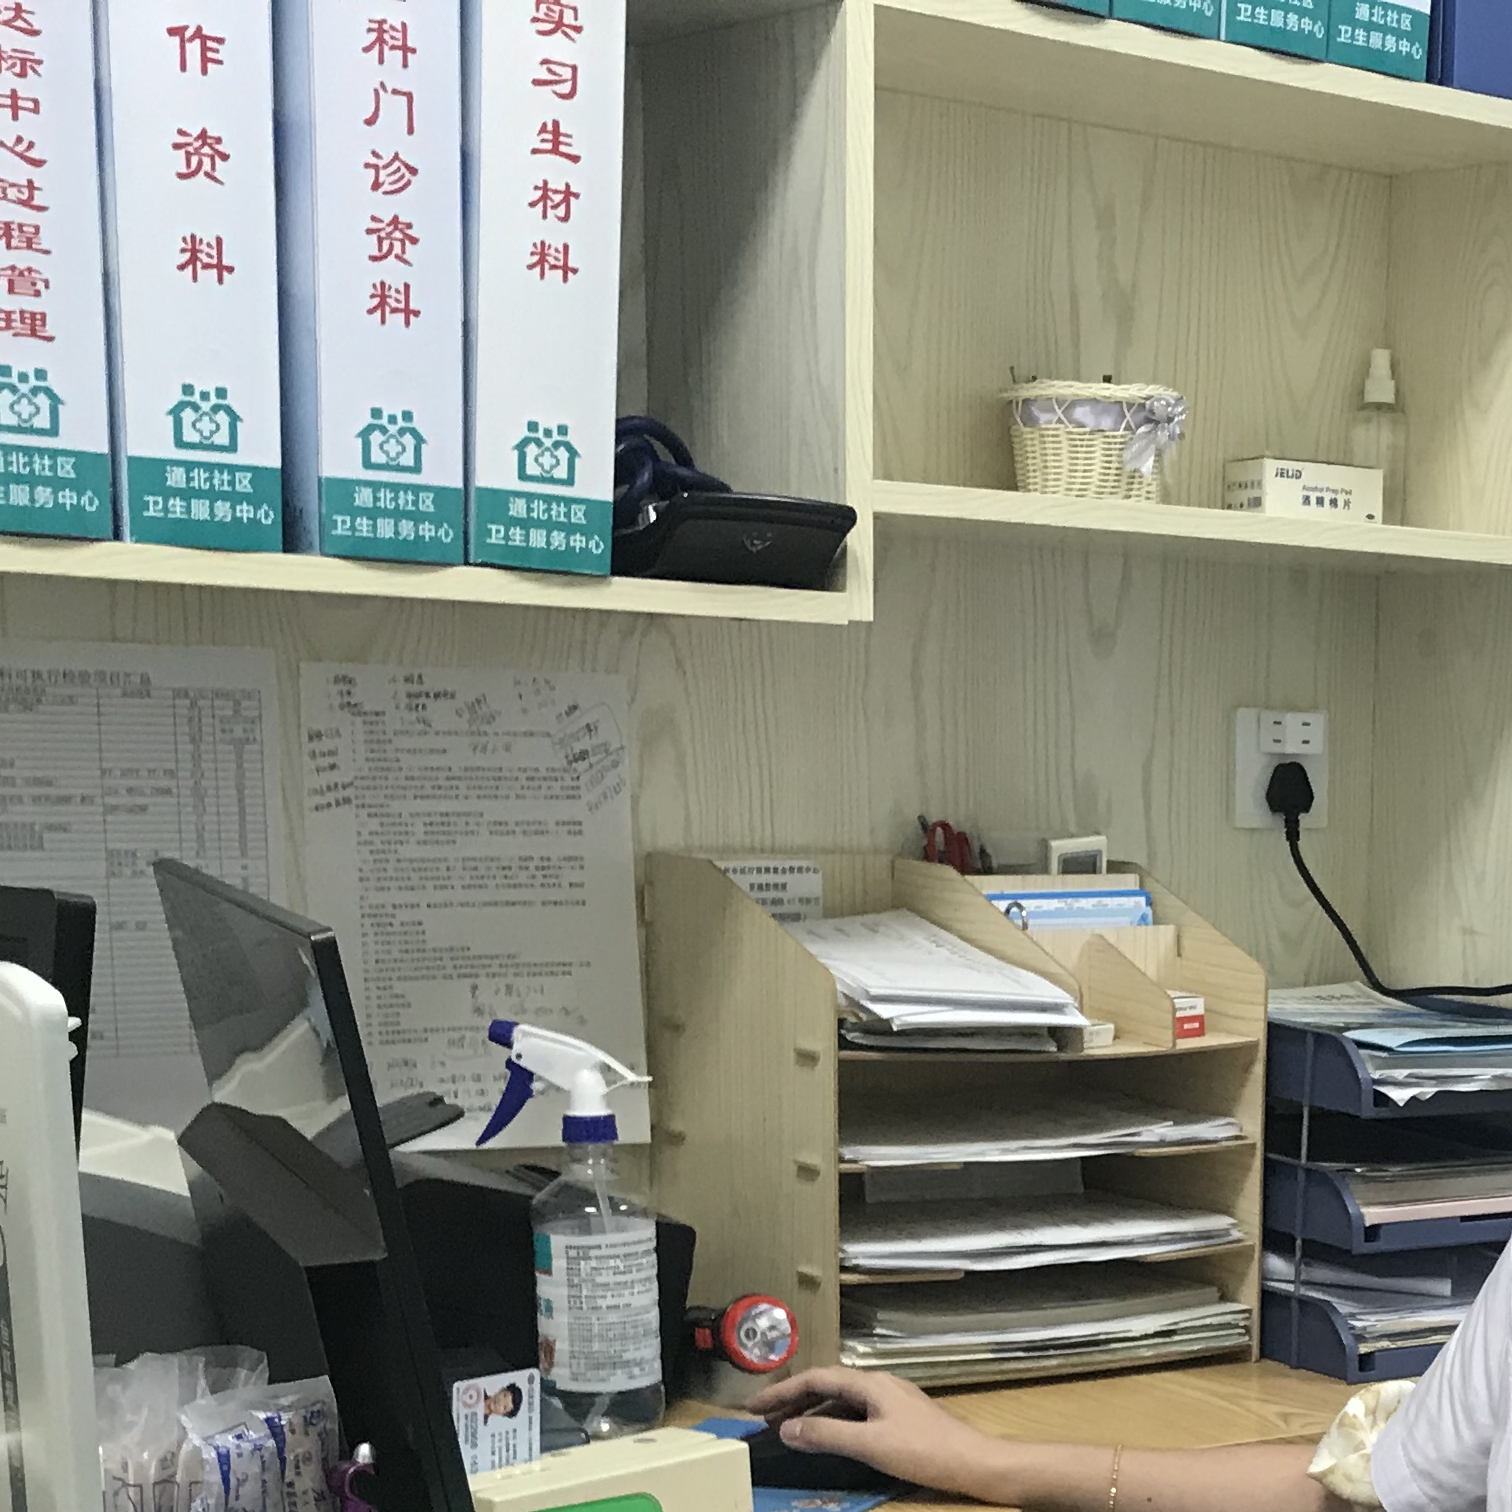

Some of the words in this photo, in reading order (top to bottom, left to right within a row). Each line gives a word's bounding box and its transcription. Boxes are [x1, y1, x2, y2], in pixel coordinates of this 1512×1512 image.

[1236, 3, 1325, 38] 卫生服务中心
[1354, 2, 1412, 31] 通北社区
[1337, 25, 1422, 60] 卫生服务中心
[167, 24, 235, 285] 作资料
[526, 0, 584, 284] 实习生材料
[361, 17, 421, 328] 科门诊资料
[0, 450, 76, 479] 北社区
[165, 466, 254, 493] 通北社区
[142, 495, 275, 525] 卫生服务中心
[353, 486, 435, 512] 通北社区
[508, 496, 587, 524] 通北社区
[331, 514, 454, 544] 卫生服务中心
[486, 523, 604, 555] 卫生服务中心
